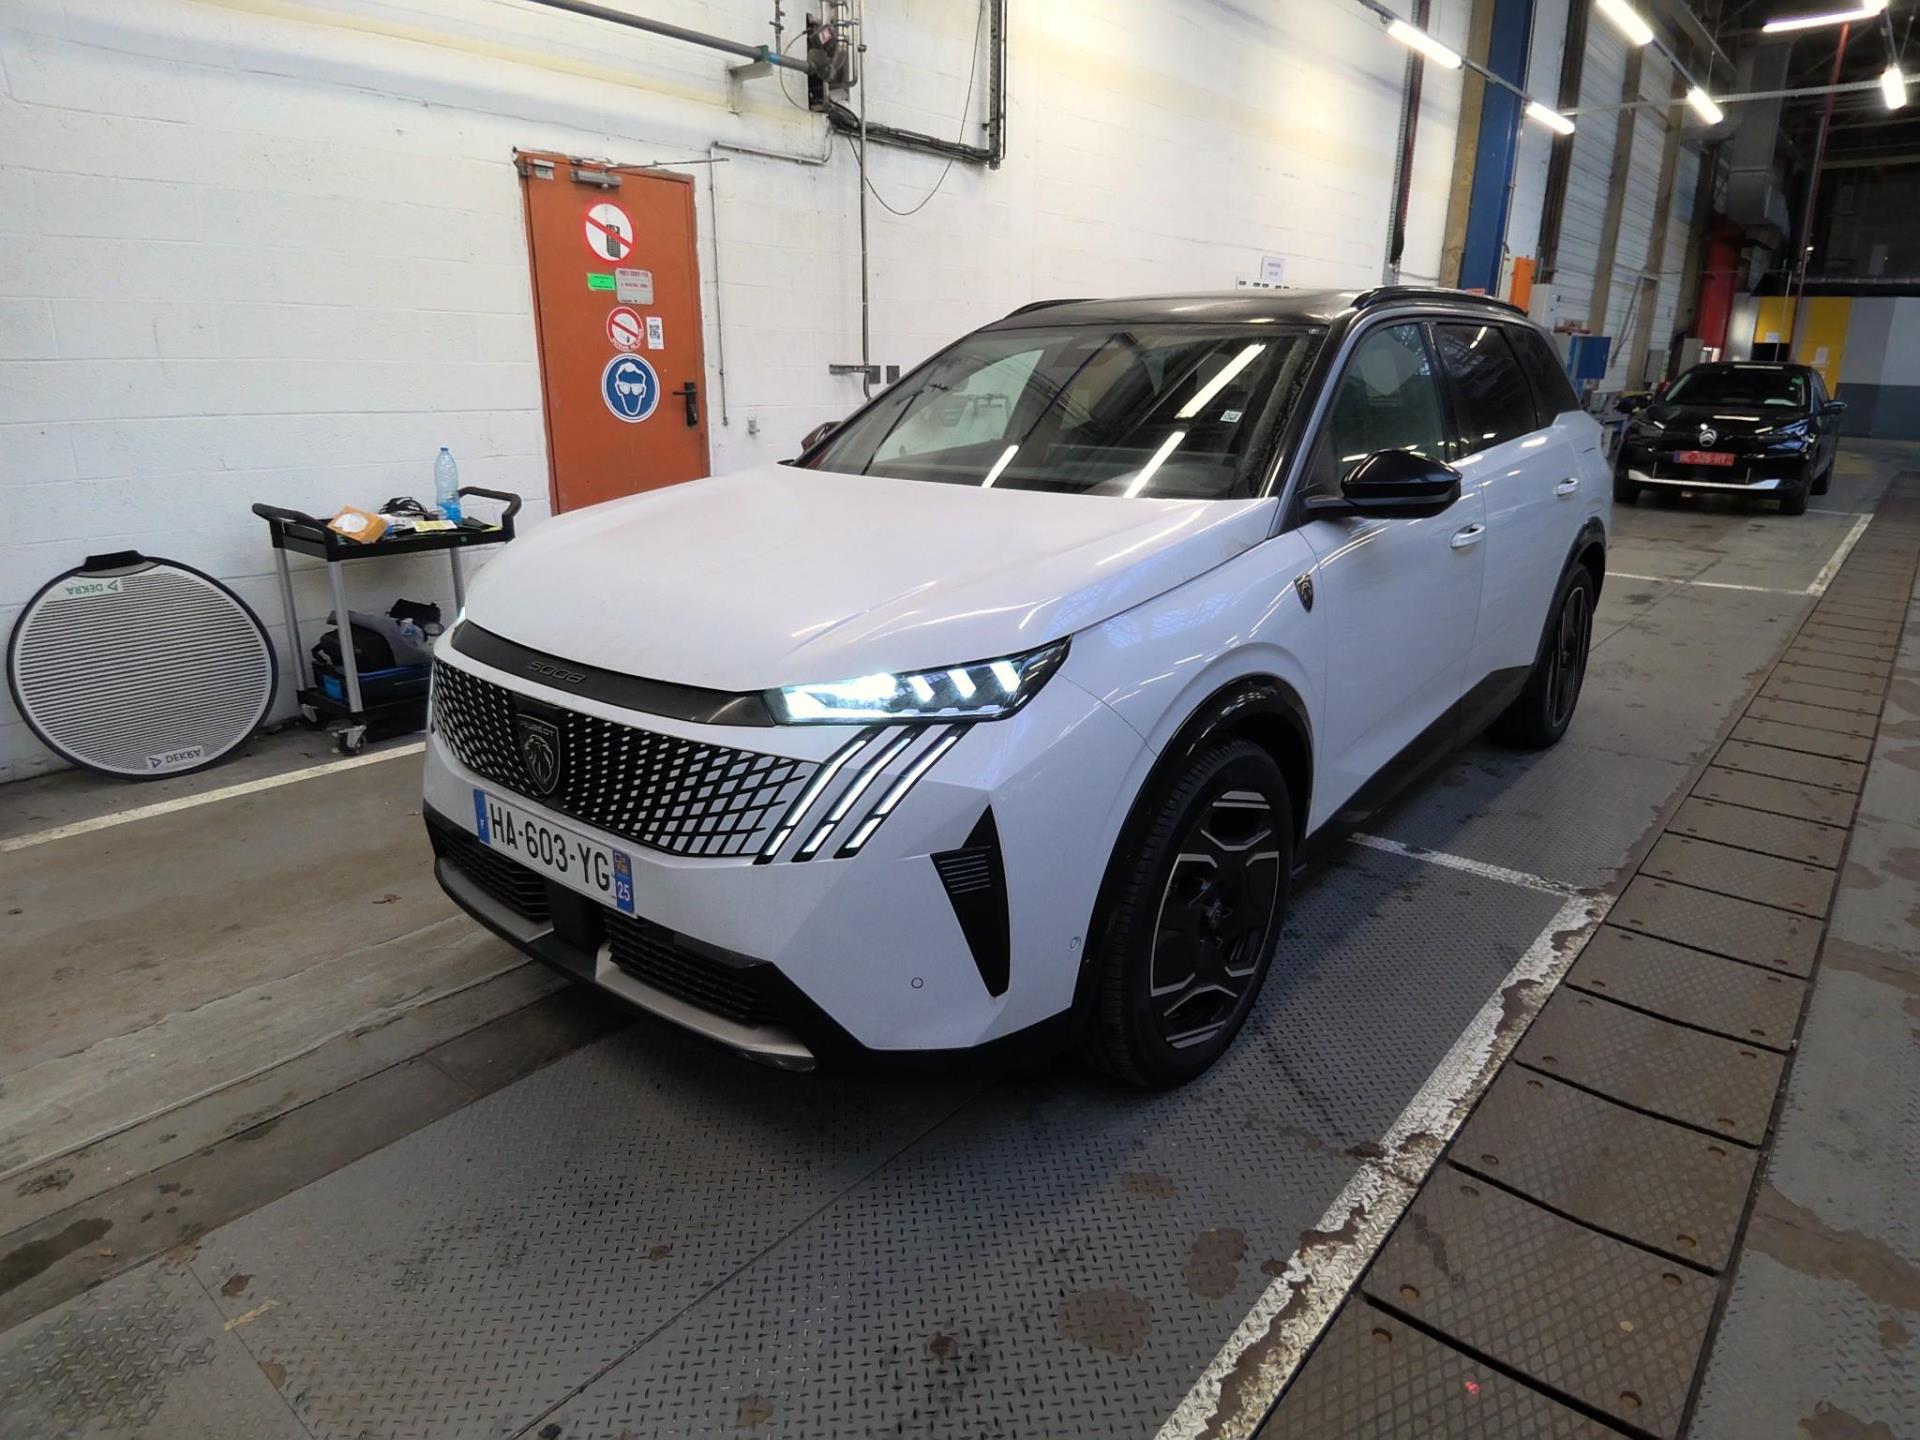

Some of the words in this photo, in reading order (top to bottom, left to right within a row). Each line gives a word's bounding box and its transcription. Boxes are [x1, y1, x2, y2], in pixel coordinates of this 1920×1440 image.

[65, 583, 103, 595] DEKRA
[528, 660, 586, 683] 5008
[165, 748, 201, 764] DEKRA
[489, 802, 611, 892] HA-603-YG
[617, 881, 631, 902] 25
